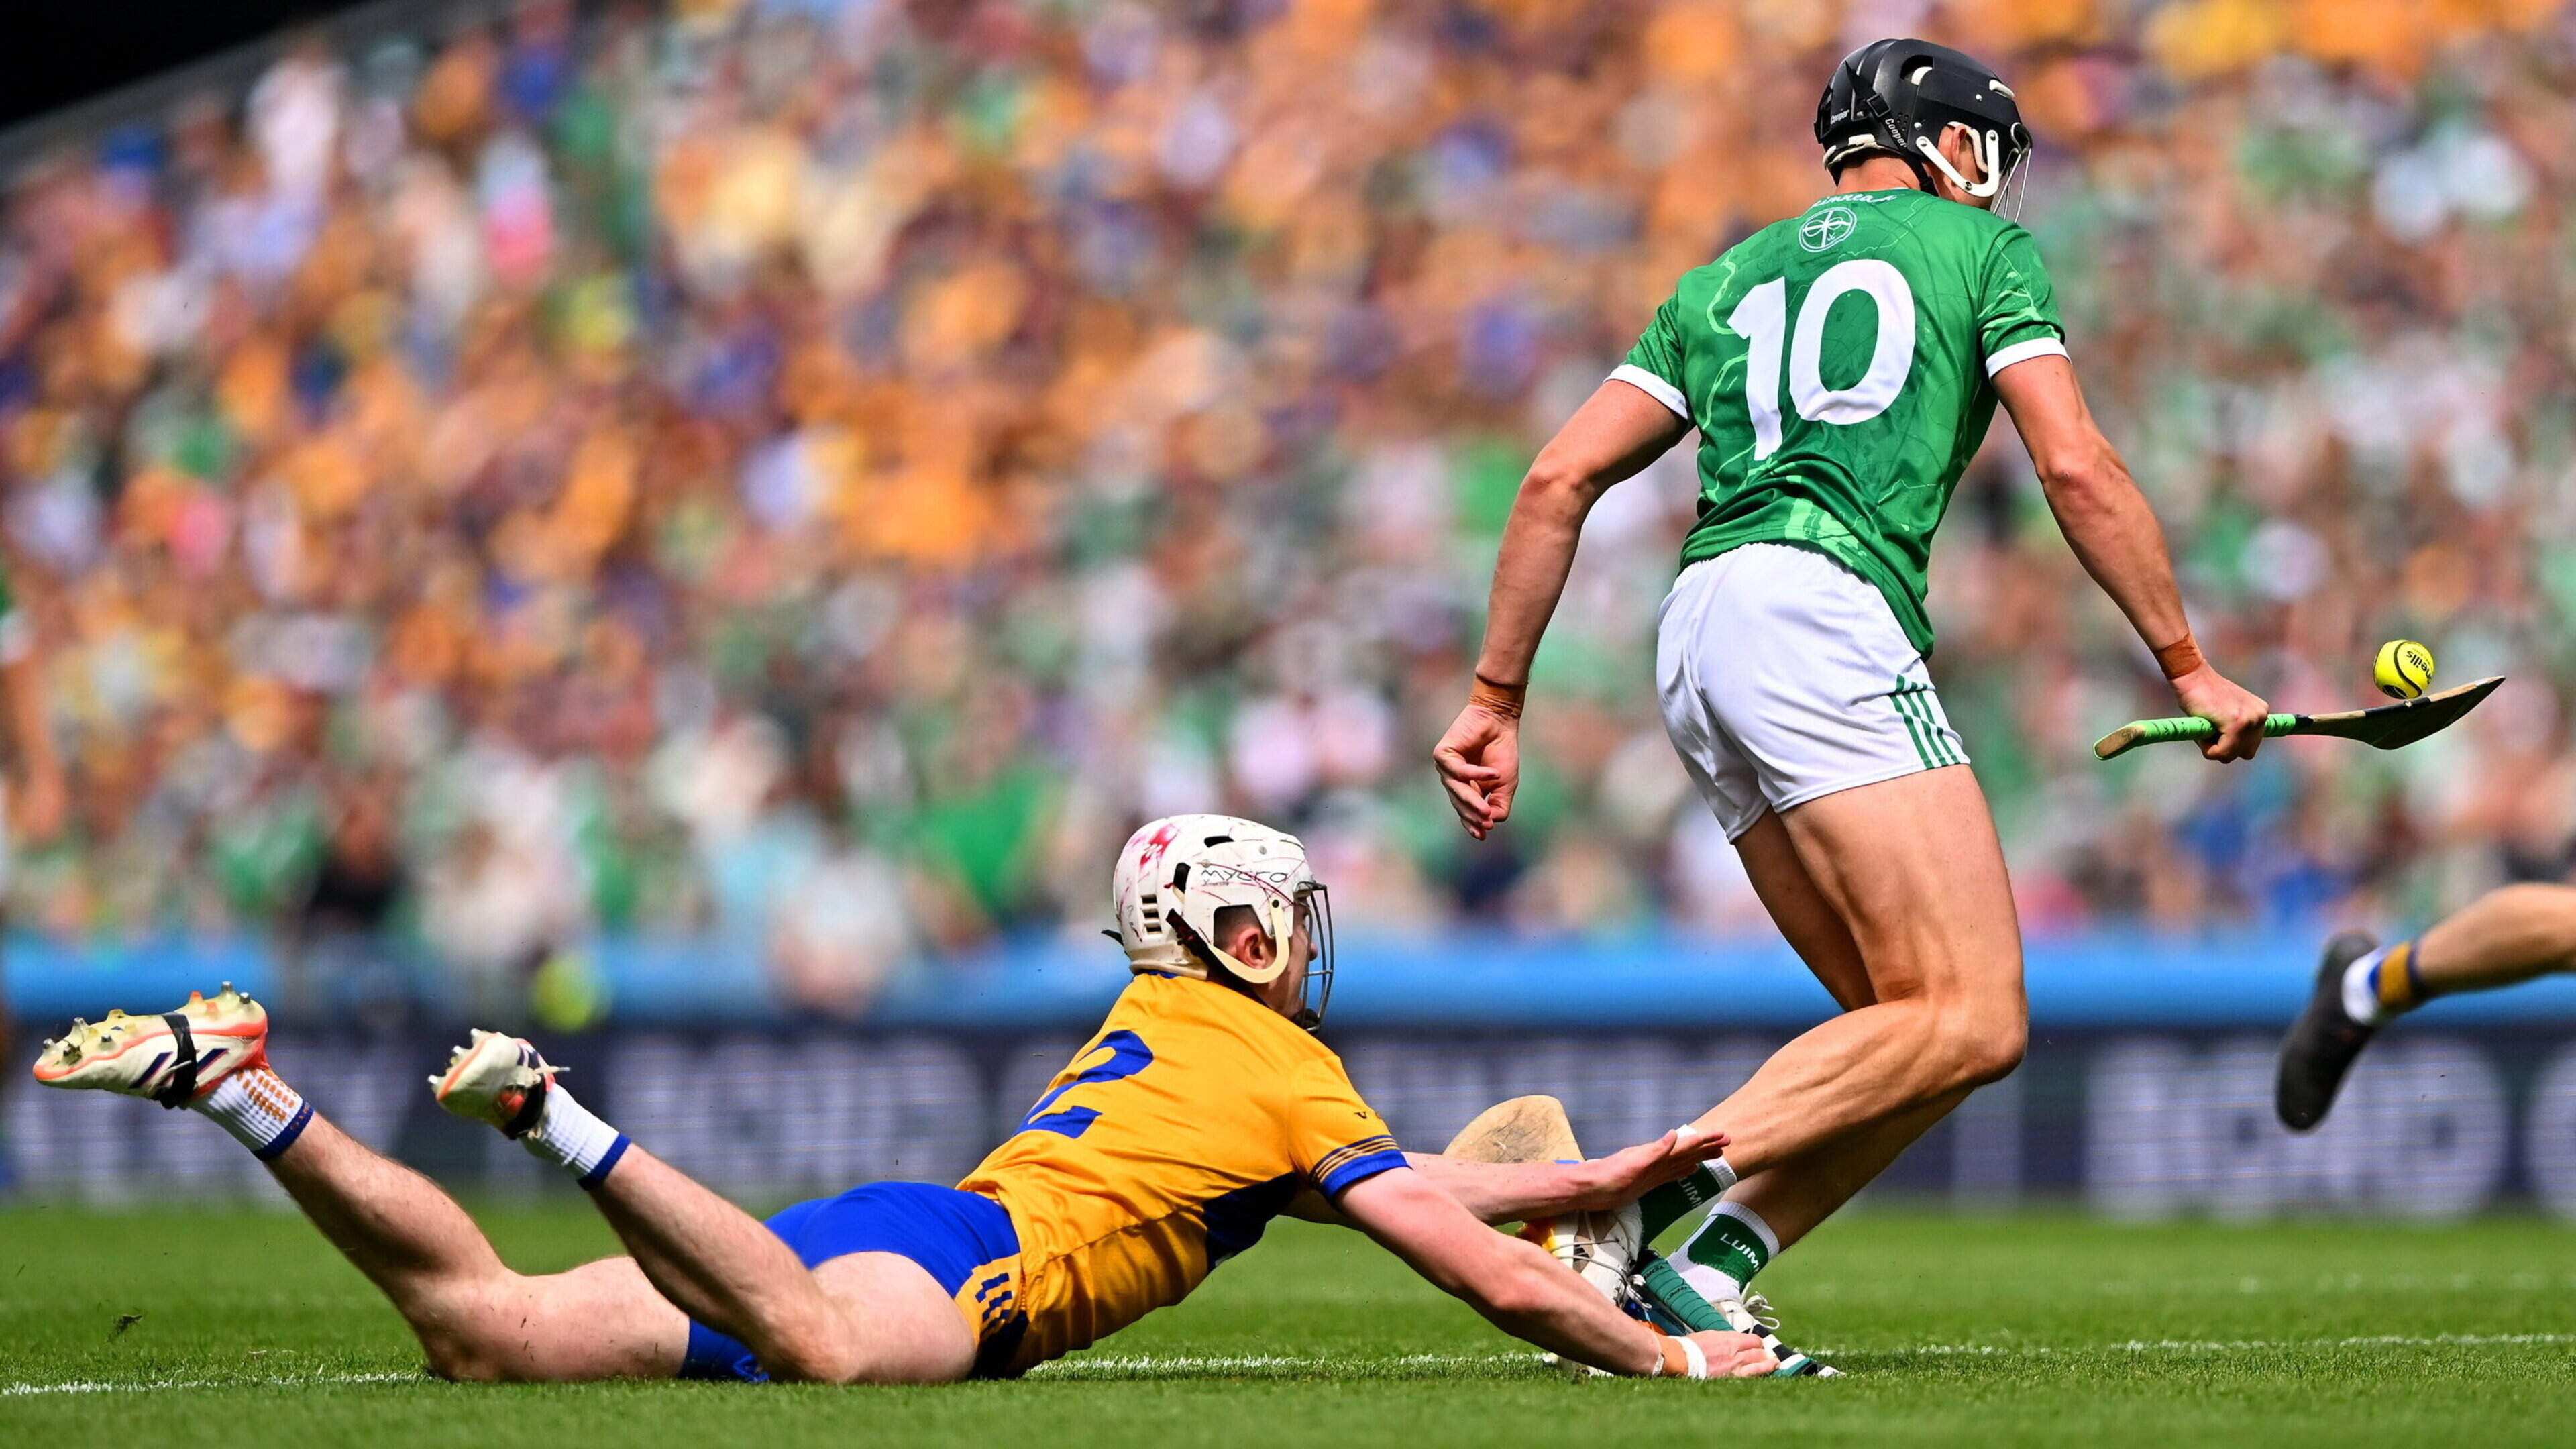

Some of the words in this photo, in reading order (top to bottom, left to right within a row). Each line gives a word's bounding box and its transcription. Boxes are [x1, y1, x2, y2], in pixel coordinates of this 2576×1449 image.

[1884, 118, 1907, 148] Cooper
[1726, 258, 1917, 461] 10
[2406, 650, 2432, 684] neills
[1012, 1030, 1155, 1140] 2
[1719, 1233, 1760, 1272] LUIM
